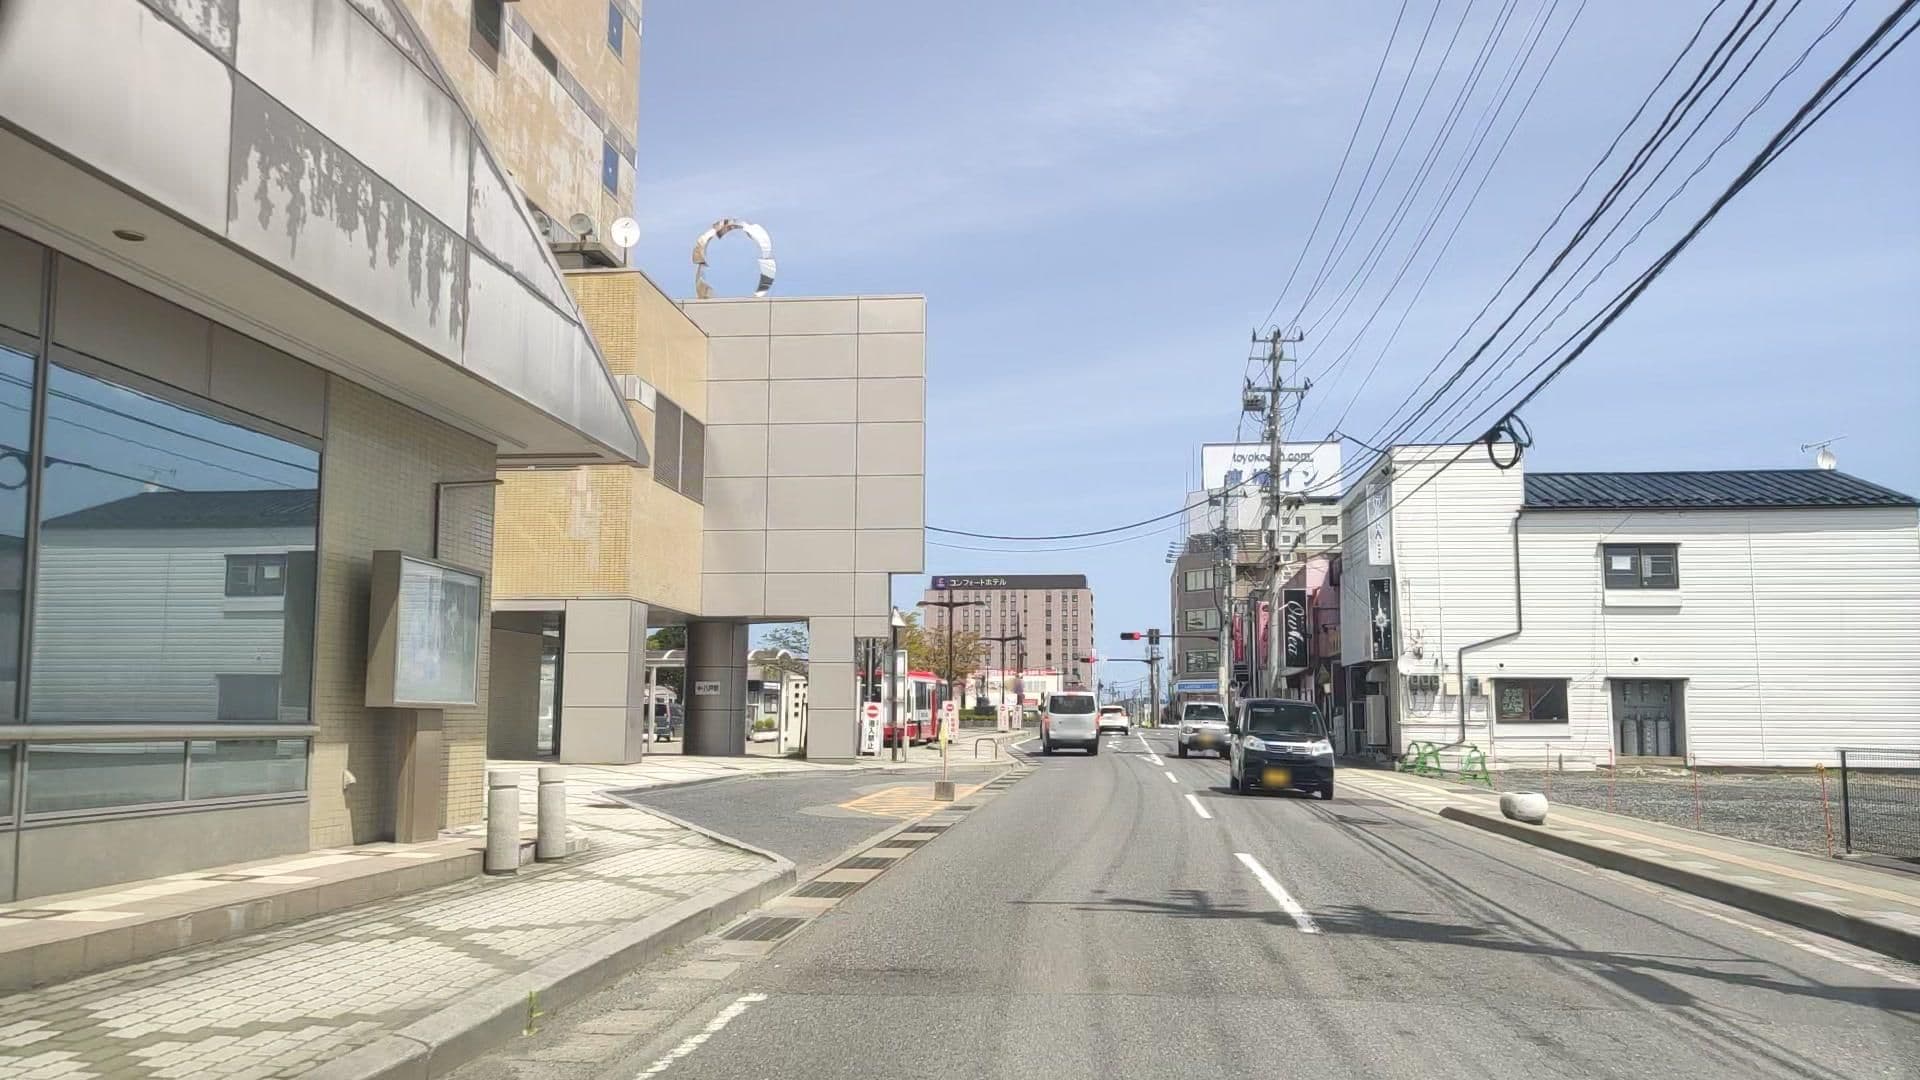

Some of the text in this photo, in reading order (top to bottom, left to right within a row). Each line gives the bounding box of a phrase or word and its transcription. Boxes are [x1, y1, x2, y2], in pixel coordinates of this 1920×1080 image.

[950, 578, 1007, 587] コンフォートホテル
